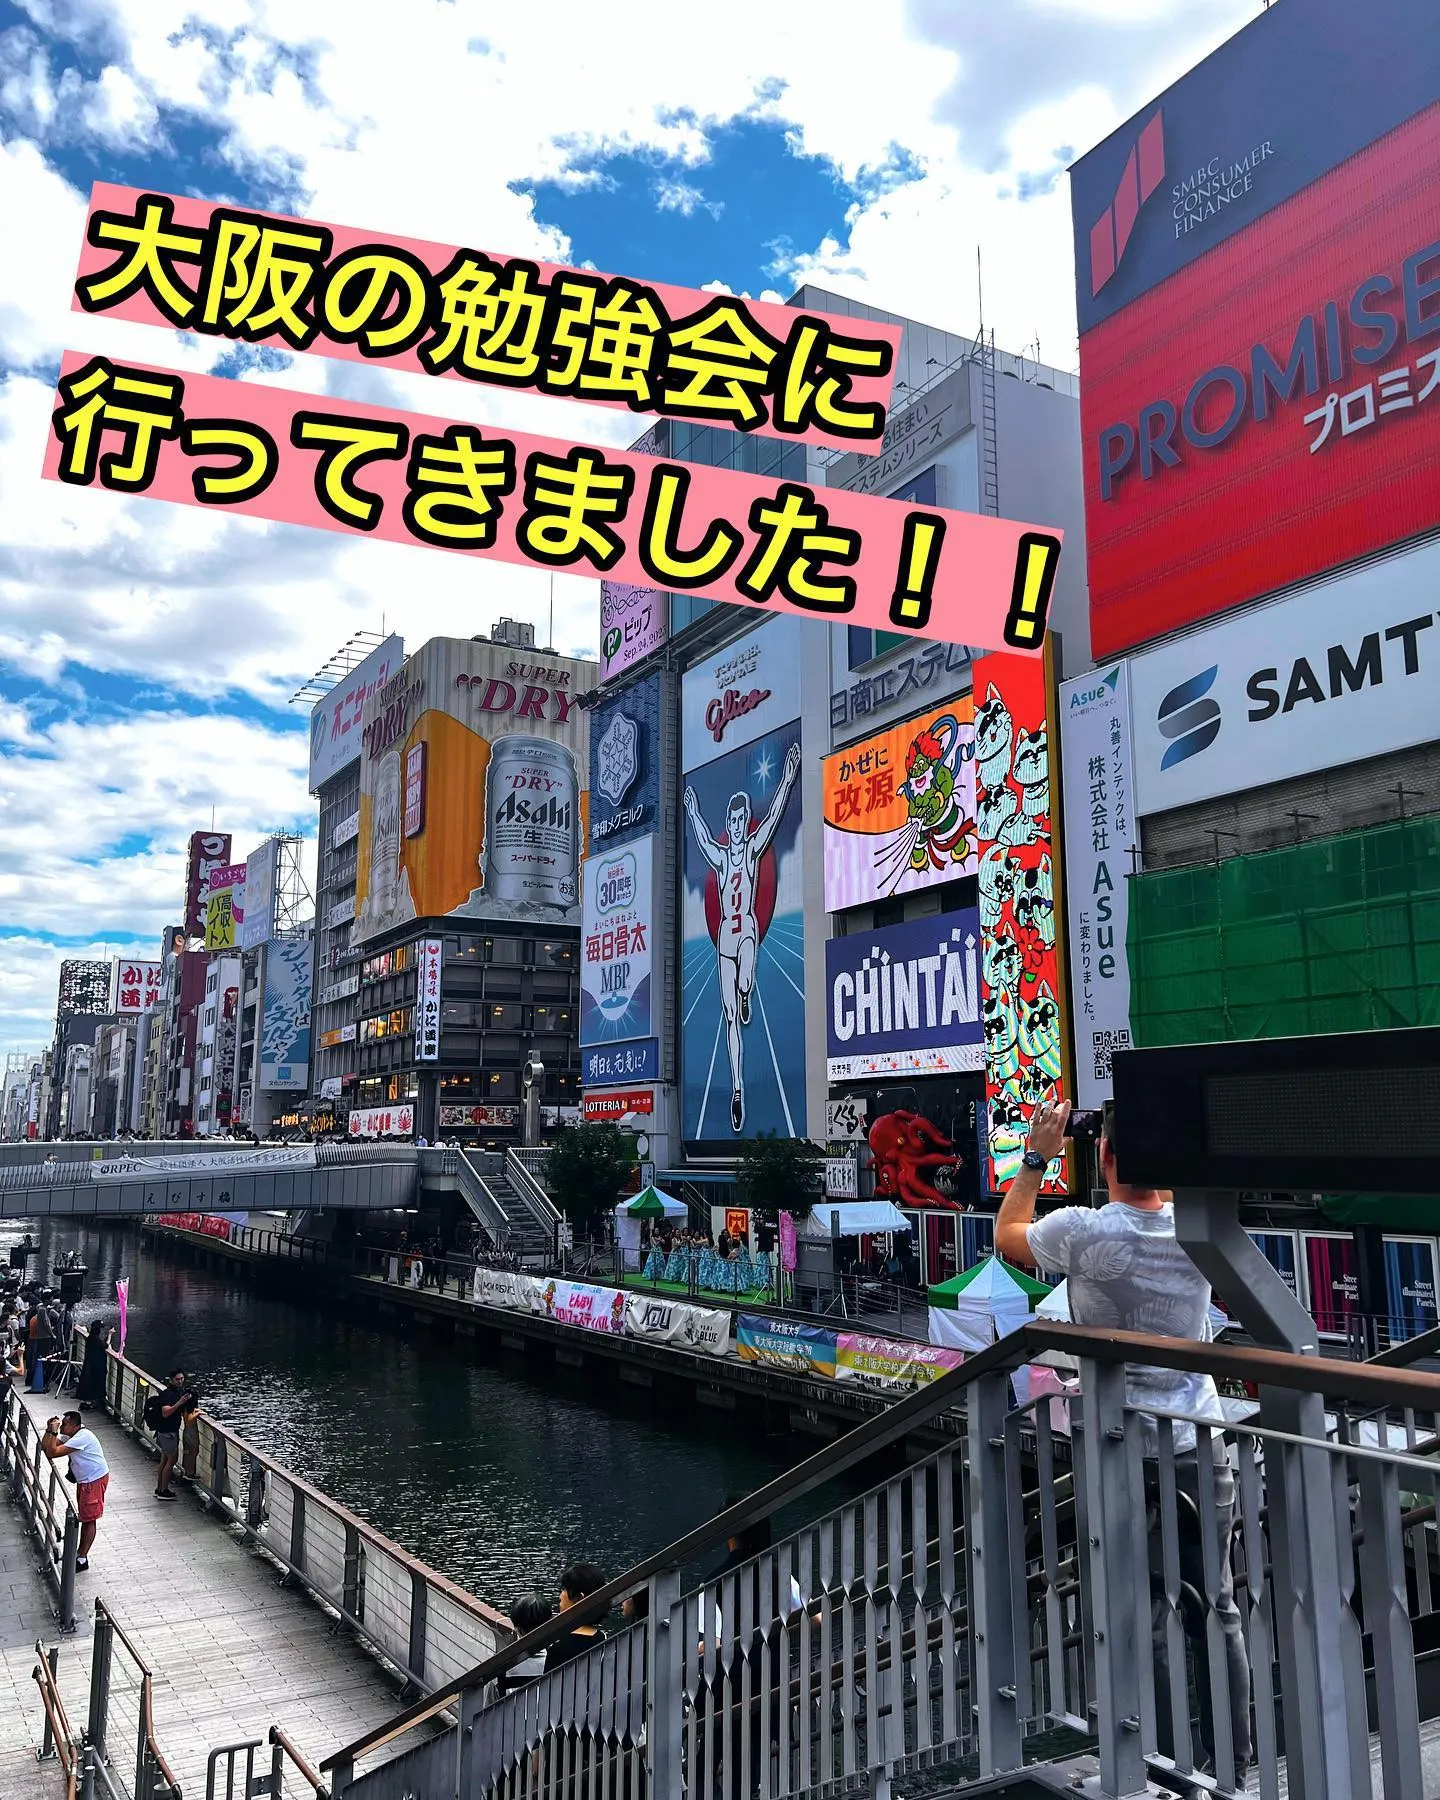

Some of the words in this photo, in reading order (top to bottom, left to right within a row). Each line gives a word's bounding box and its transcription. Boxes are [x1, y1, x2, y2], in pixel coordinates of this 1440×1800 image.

[1172, 156, 1220, 204] SMBC
[1172, 141, 1276, 220] CONSUMER
[1174, 172, 1254, 240] FINANCE
[1098, 238, 1440, 501] PROMISE
[624, 604, 653, 643] ピップ
[505, 661, 572, 687] SUPER
[1246, 611, 1440, 723] SAMT
[705, 688, 772, 743] Glico
[1069, 685, 1106, 709] Asue
[520, 767, 550, 777] SUPER
[838, 747, 889, 784] かぜに
[1108, 715, 1128, 837] 丸善インテックは、
[495, 790, 571, 831] Asahi
[833, 766, 895, 825] 改源
[1087, 754, 1111, 853] 株式会社
[523, 829, 544, 844] 生
[591, 803, 644, 842] 雪印メグミルク
[510, 854, 556, 866] スーパードライ
[559, 881, 576, 897] お酒
[600, 875, 632, 907] 30周年
[729, 866, 745, 935] グリコ
[208, 896, 221, 947] バイト
[219, 894, 233, 946] 高収入
[593, 911, 638, 932] まいにちほねぶと
[1092, 860, 1116, 979] Asue
[585, 921, 648, 963] 毎日骨太
[600, 962, 631, 995] MBP
[1078, 911, 1095, 1021] に変わりました。
[585, 1100, 620, 1113] LOTTERIA
[833, 1104, 859, 1135] くくる
[146, 1191, 231, 1205] えびす橋
[1342, 1273, 1358, 1284] Stree
[1413, 1279, 1432, 1290] Street
